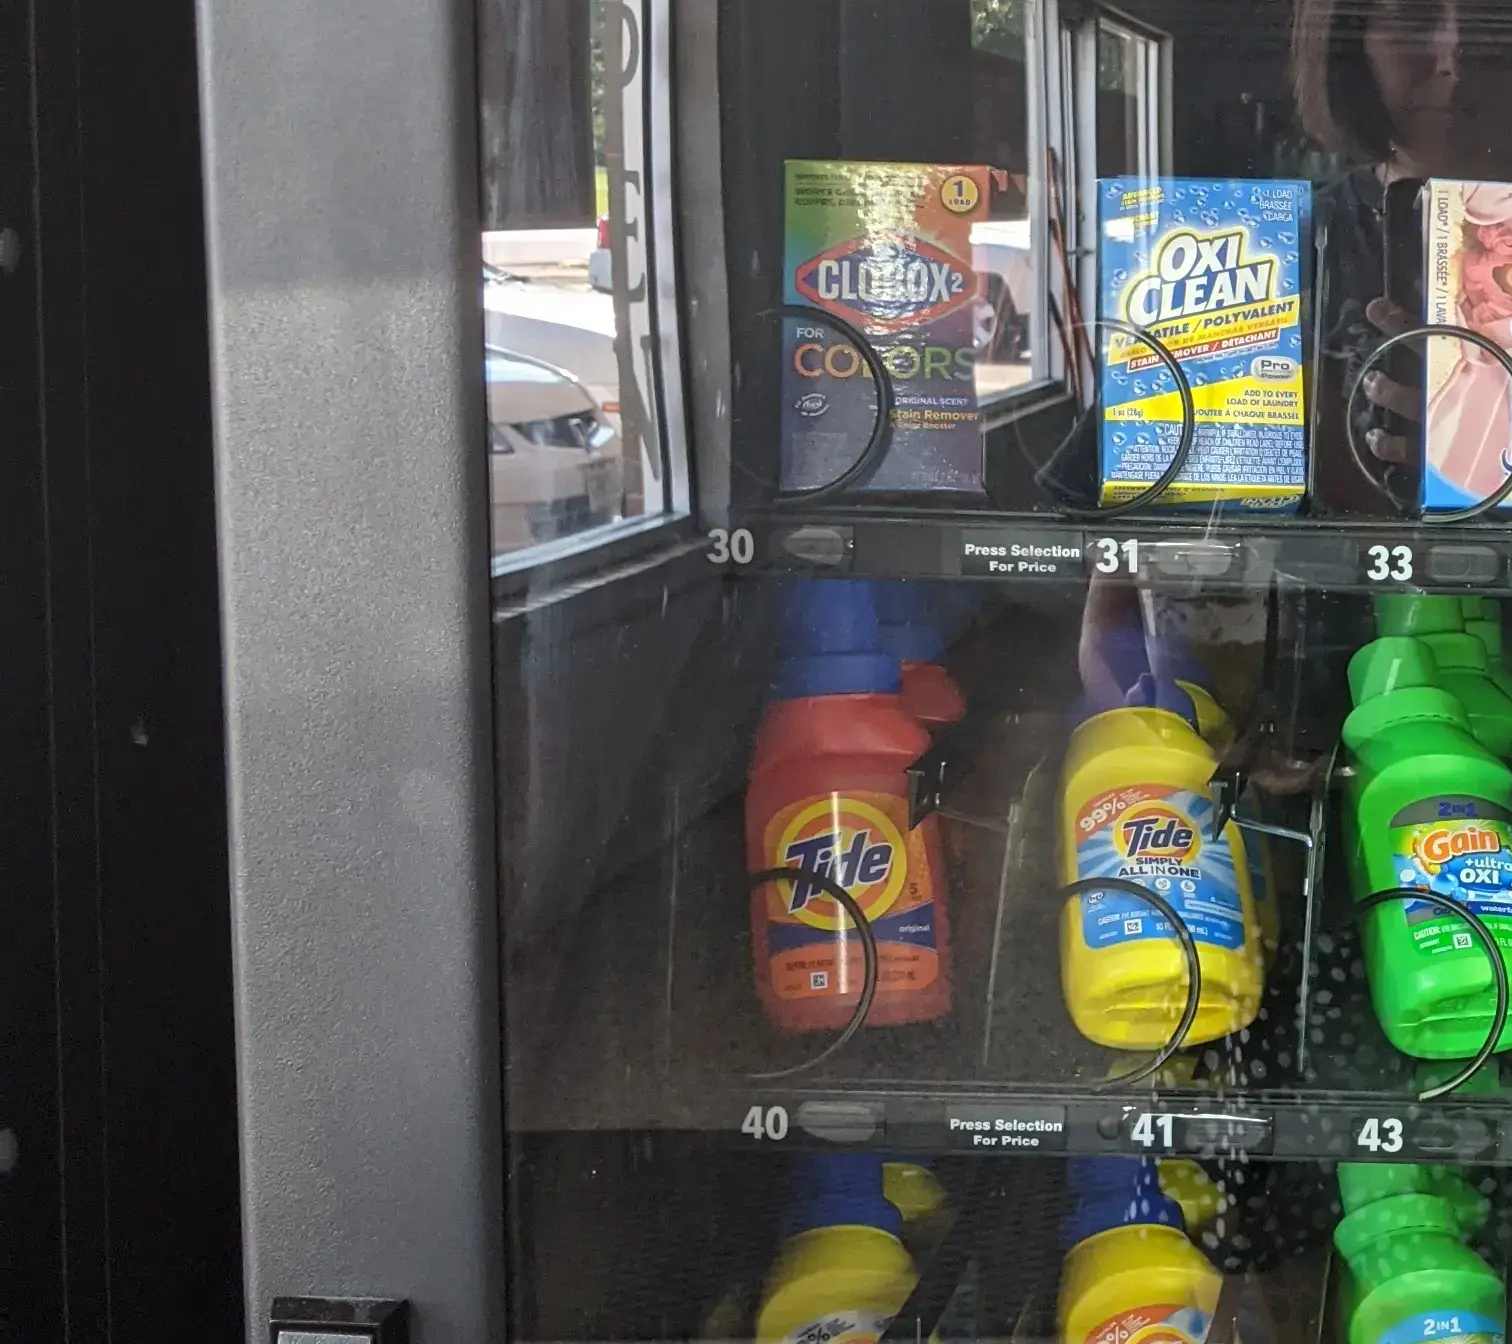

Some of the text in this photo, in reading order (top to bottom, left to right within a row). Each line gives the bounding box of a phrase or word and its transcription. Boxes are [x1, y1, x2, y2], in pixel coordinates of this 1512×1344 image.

[1158, 232, 1242, 281] OXI
[1128, 260, 1274, 326] CLEAN
[1203, 301, 1294, 328] POLYVALENT
[1261, 359, 1290, 370] Pro
[707, 529, 753, 564] 30
[1095, 540, 1138, 573] 31
[1366, 546, 1413, 581] 33
[1122, 817, 1194, 858] Tide
[1423, 826, 1500, 864] Gain
[785, 829, 893, 914] Tide
[1118, 867, 1200, 878] ALL IN ONE
[1136, 857, 1183, 866] SIMPLY
[1460, 868, 1500, 884] OXI
[899, 924, 930, 933] original
[741, 1106, 788, 1139] 40
[1130, 1113, 1172, 1146] 41
[1358, 1119, 1403, 1152] 43
